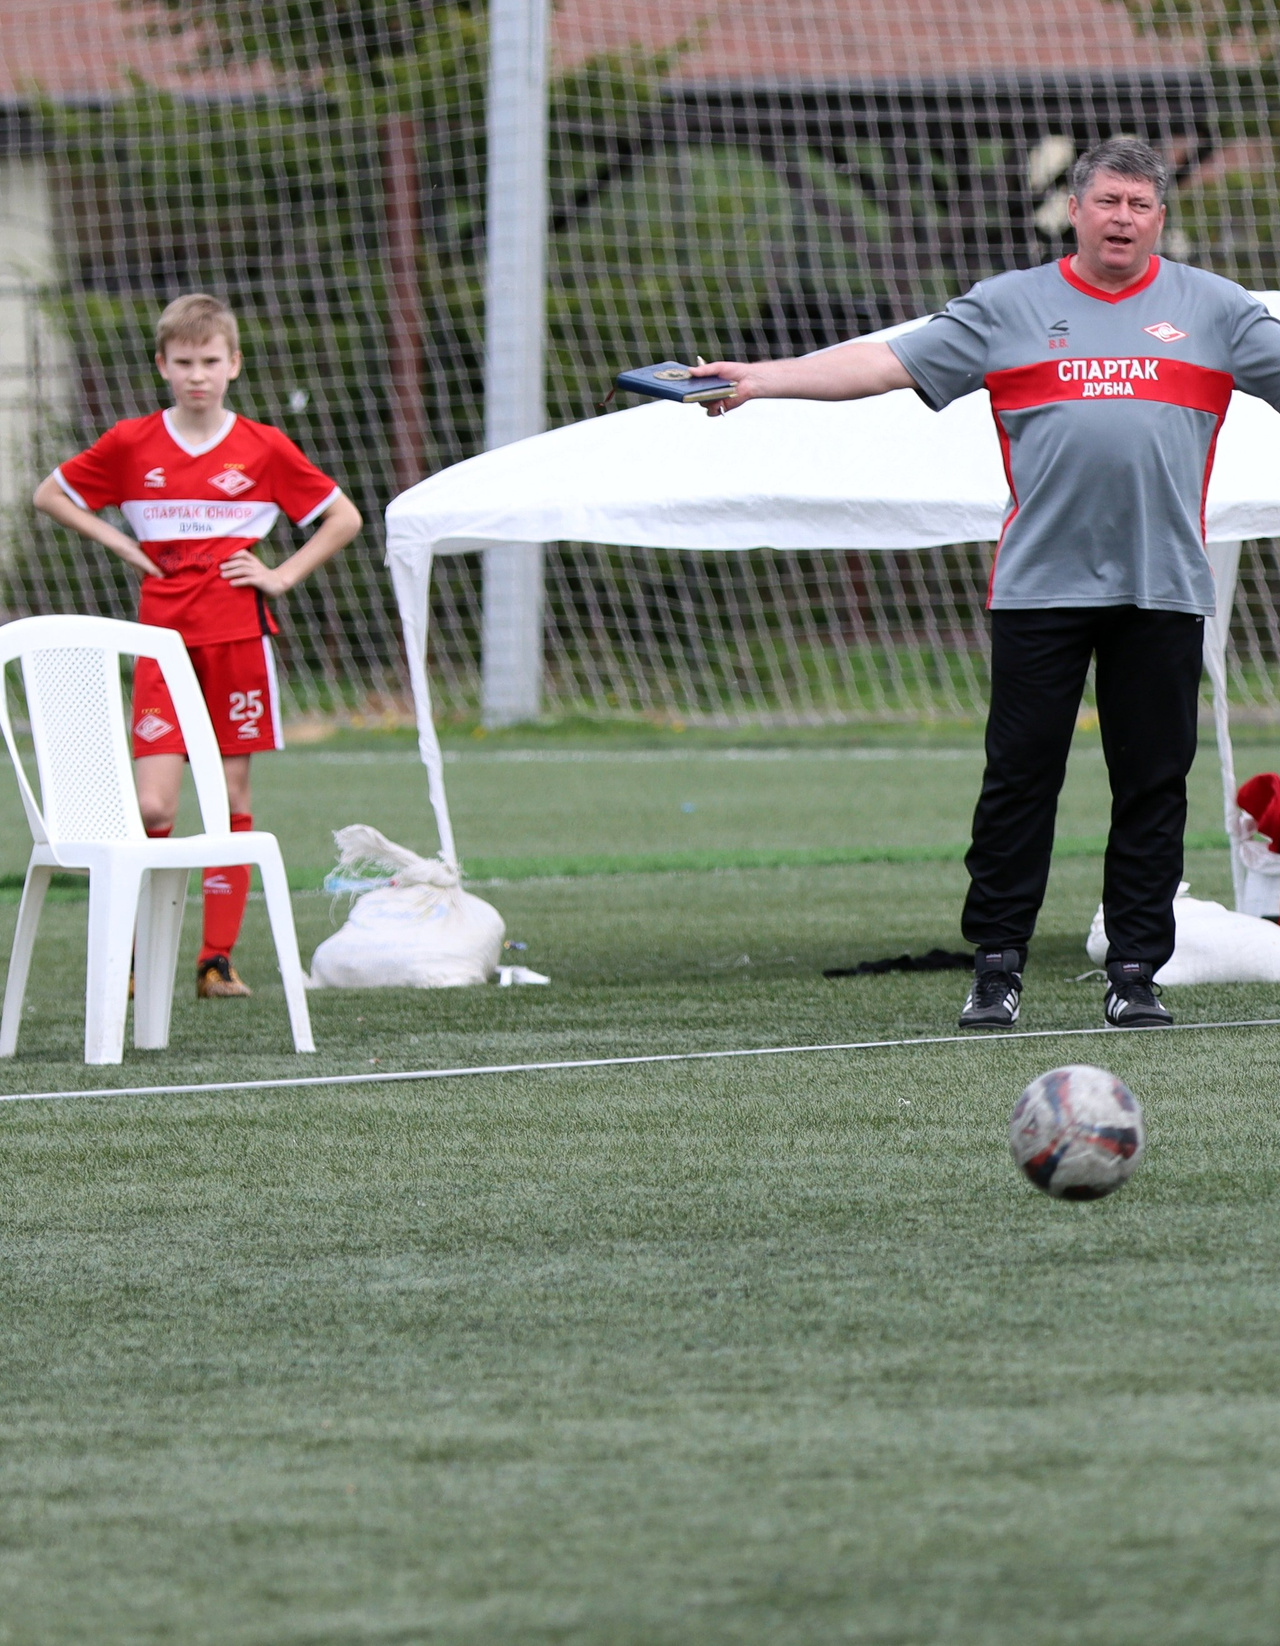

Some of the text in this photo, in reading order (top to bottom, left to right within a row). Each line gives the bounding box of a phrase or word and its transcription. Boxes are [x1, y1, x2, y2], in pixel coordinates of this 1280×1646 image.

[1058, 359, 1159, 381] СПАРТАК
[1082, 382, 1134, 397] ДУБНА
[143, 505, 252, 521] СПАРТАК ЮНИОР
[179, 521, 213, 534] ДУБНА
[229, 689, 264, 721] 25
